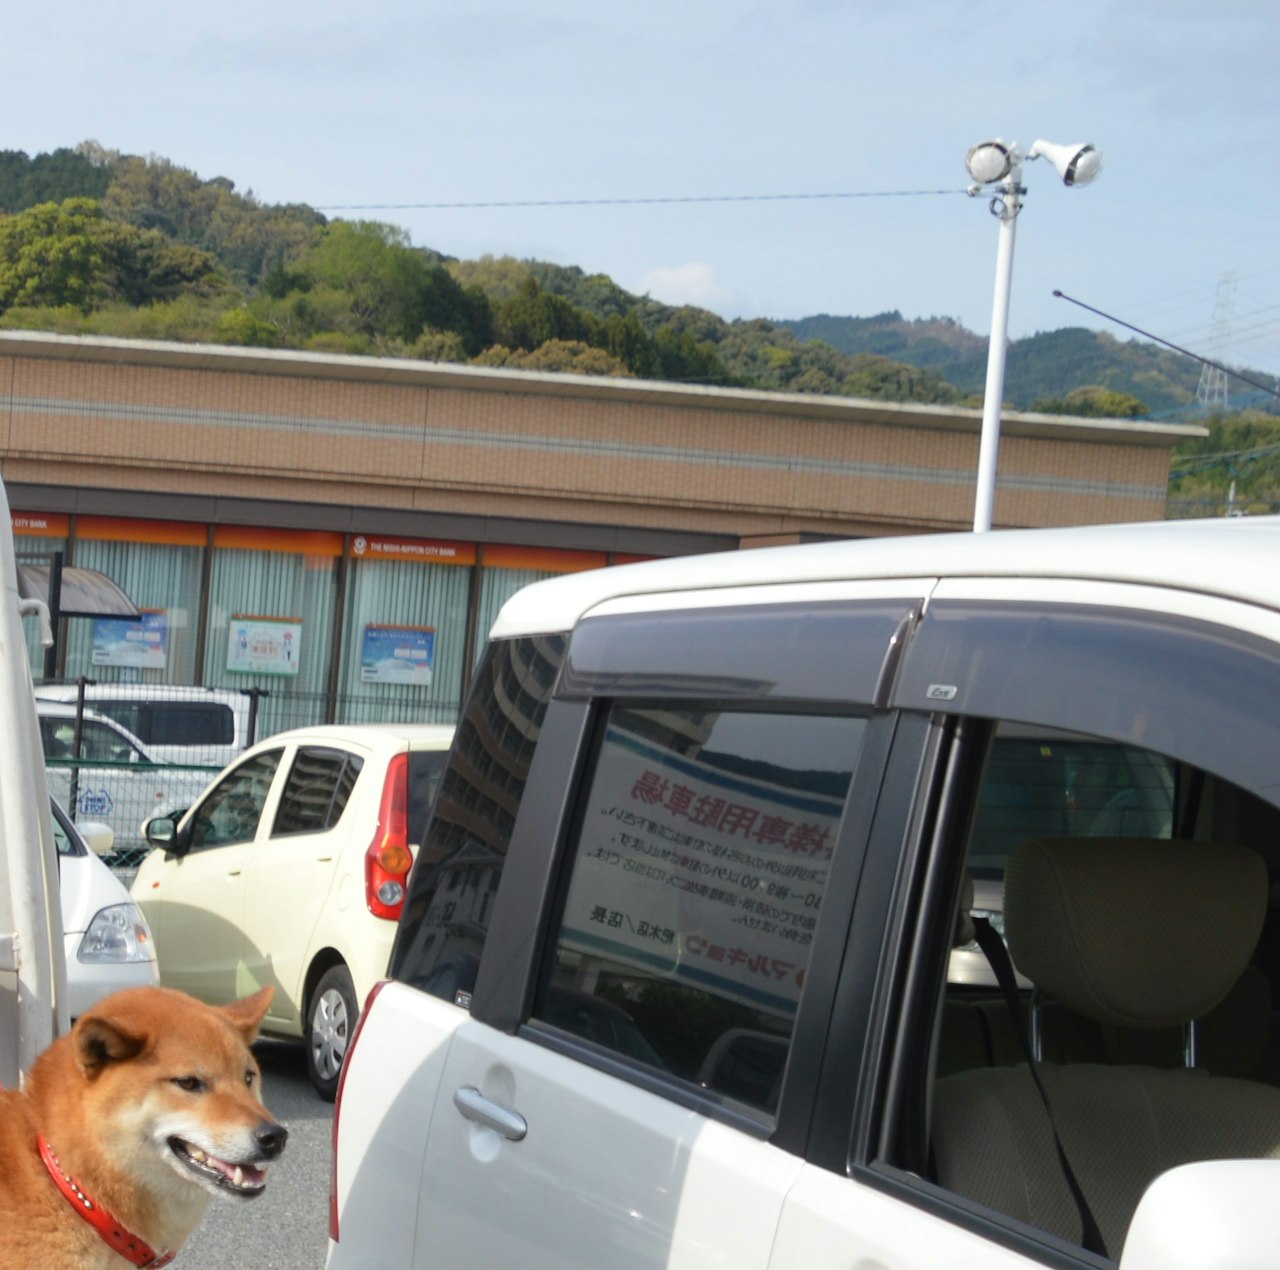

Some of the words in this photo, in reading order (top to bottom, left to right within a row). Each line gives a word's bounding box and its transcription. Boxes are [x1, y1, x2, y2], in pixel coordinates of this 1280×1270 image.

[29, 520, 48, 528] BANK
[425, 546, 438, 555] CITY
[439, 547, 456, 556] BANK
